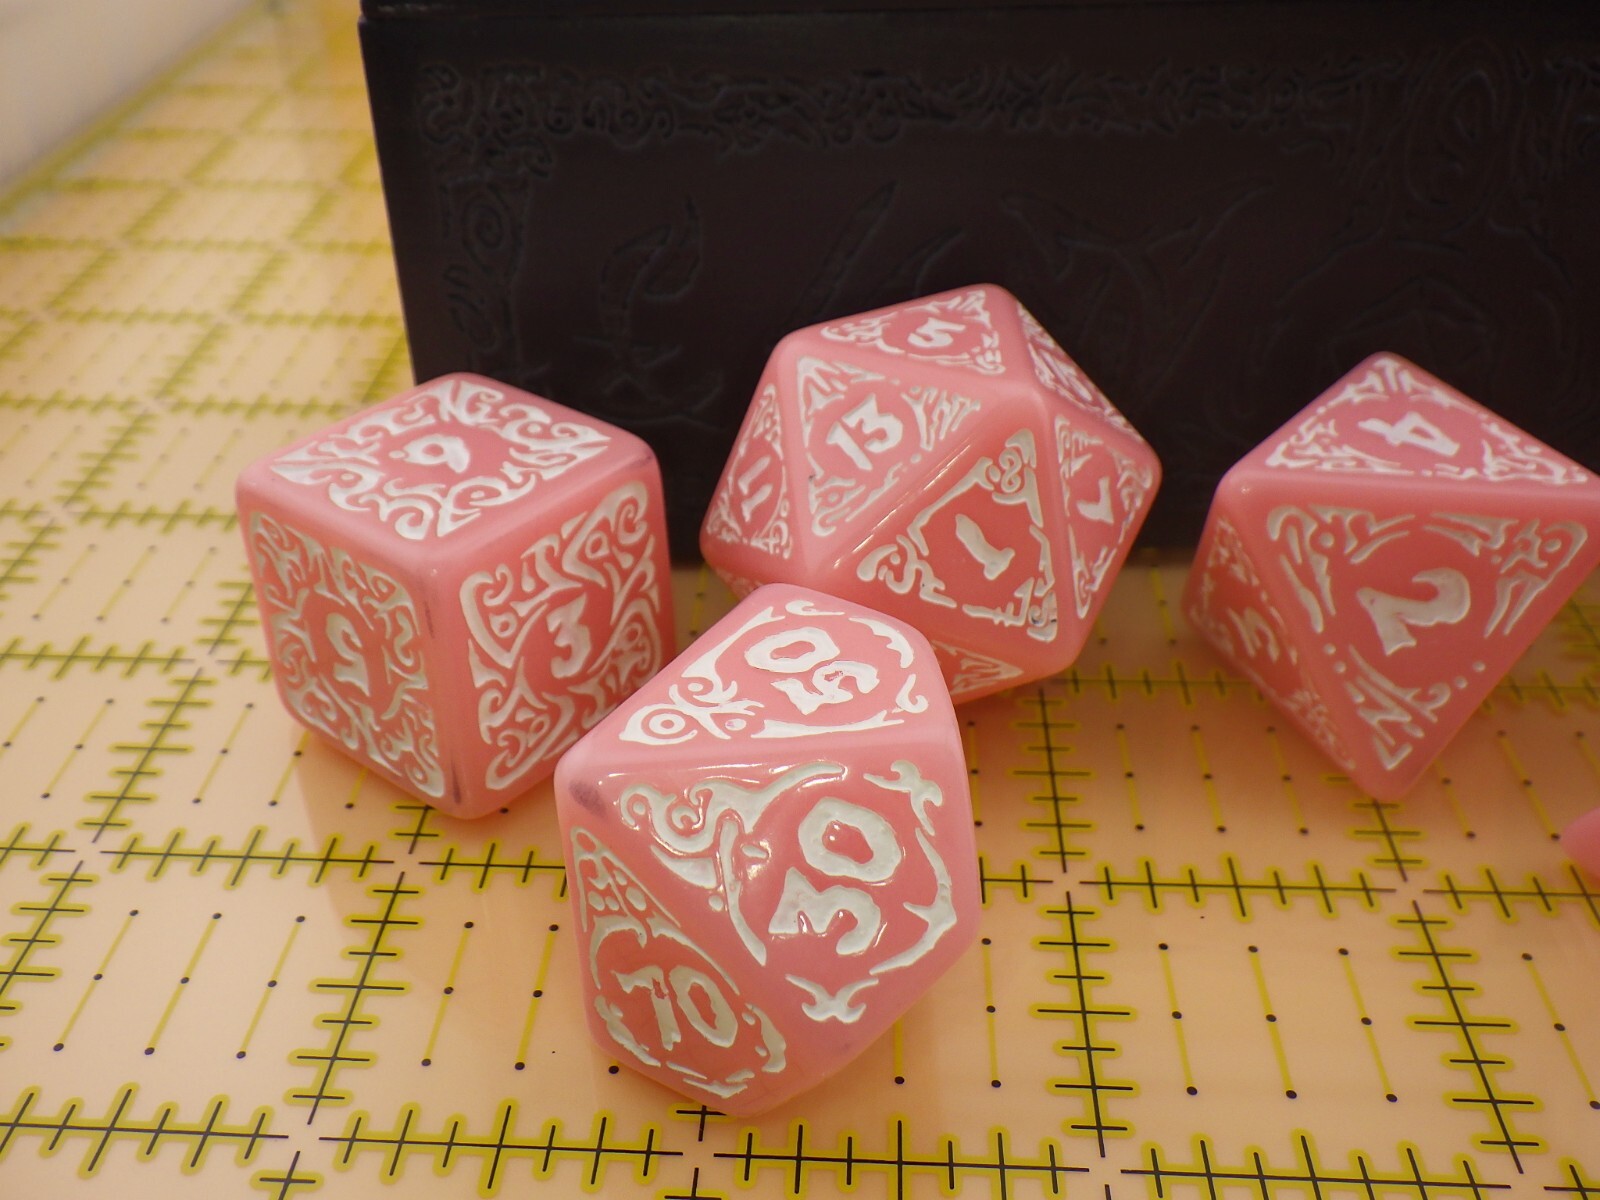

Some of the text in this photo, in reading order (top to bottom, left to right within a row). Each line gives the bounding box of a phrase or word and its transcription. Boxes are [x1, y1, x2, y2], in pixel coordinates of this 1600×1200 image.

[826, 393, 904, 471] 13
[1357, 411, 1461, 456] 4
[954, 513, 1017, 580] 1
[546, 594, 595, 679] 3
[1356, 567, 1471, 656] 2
[610, 964, 739, 1050] 70
